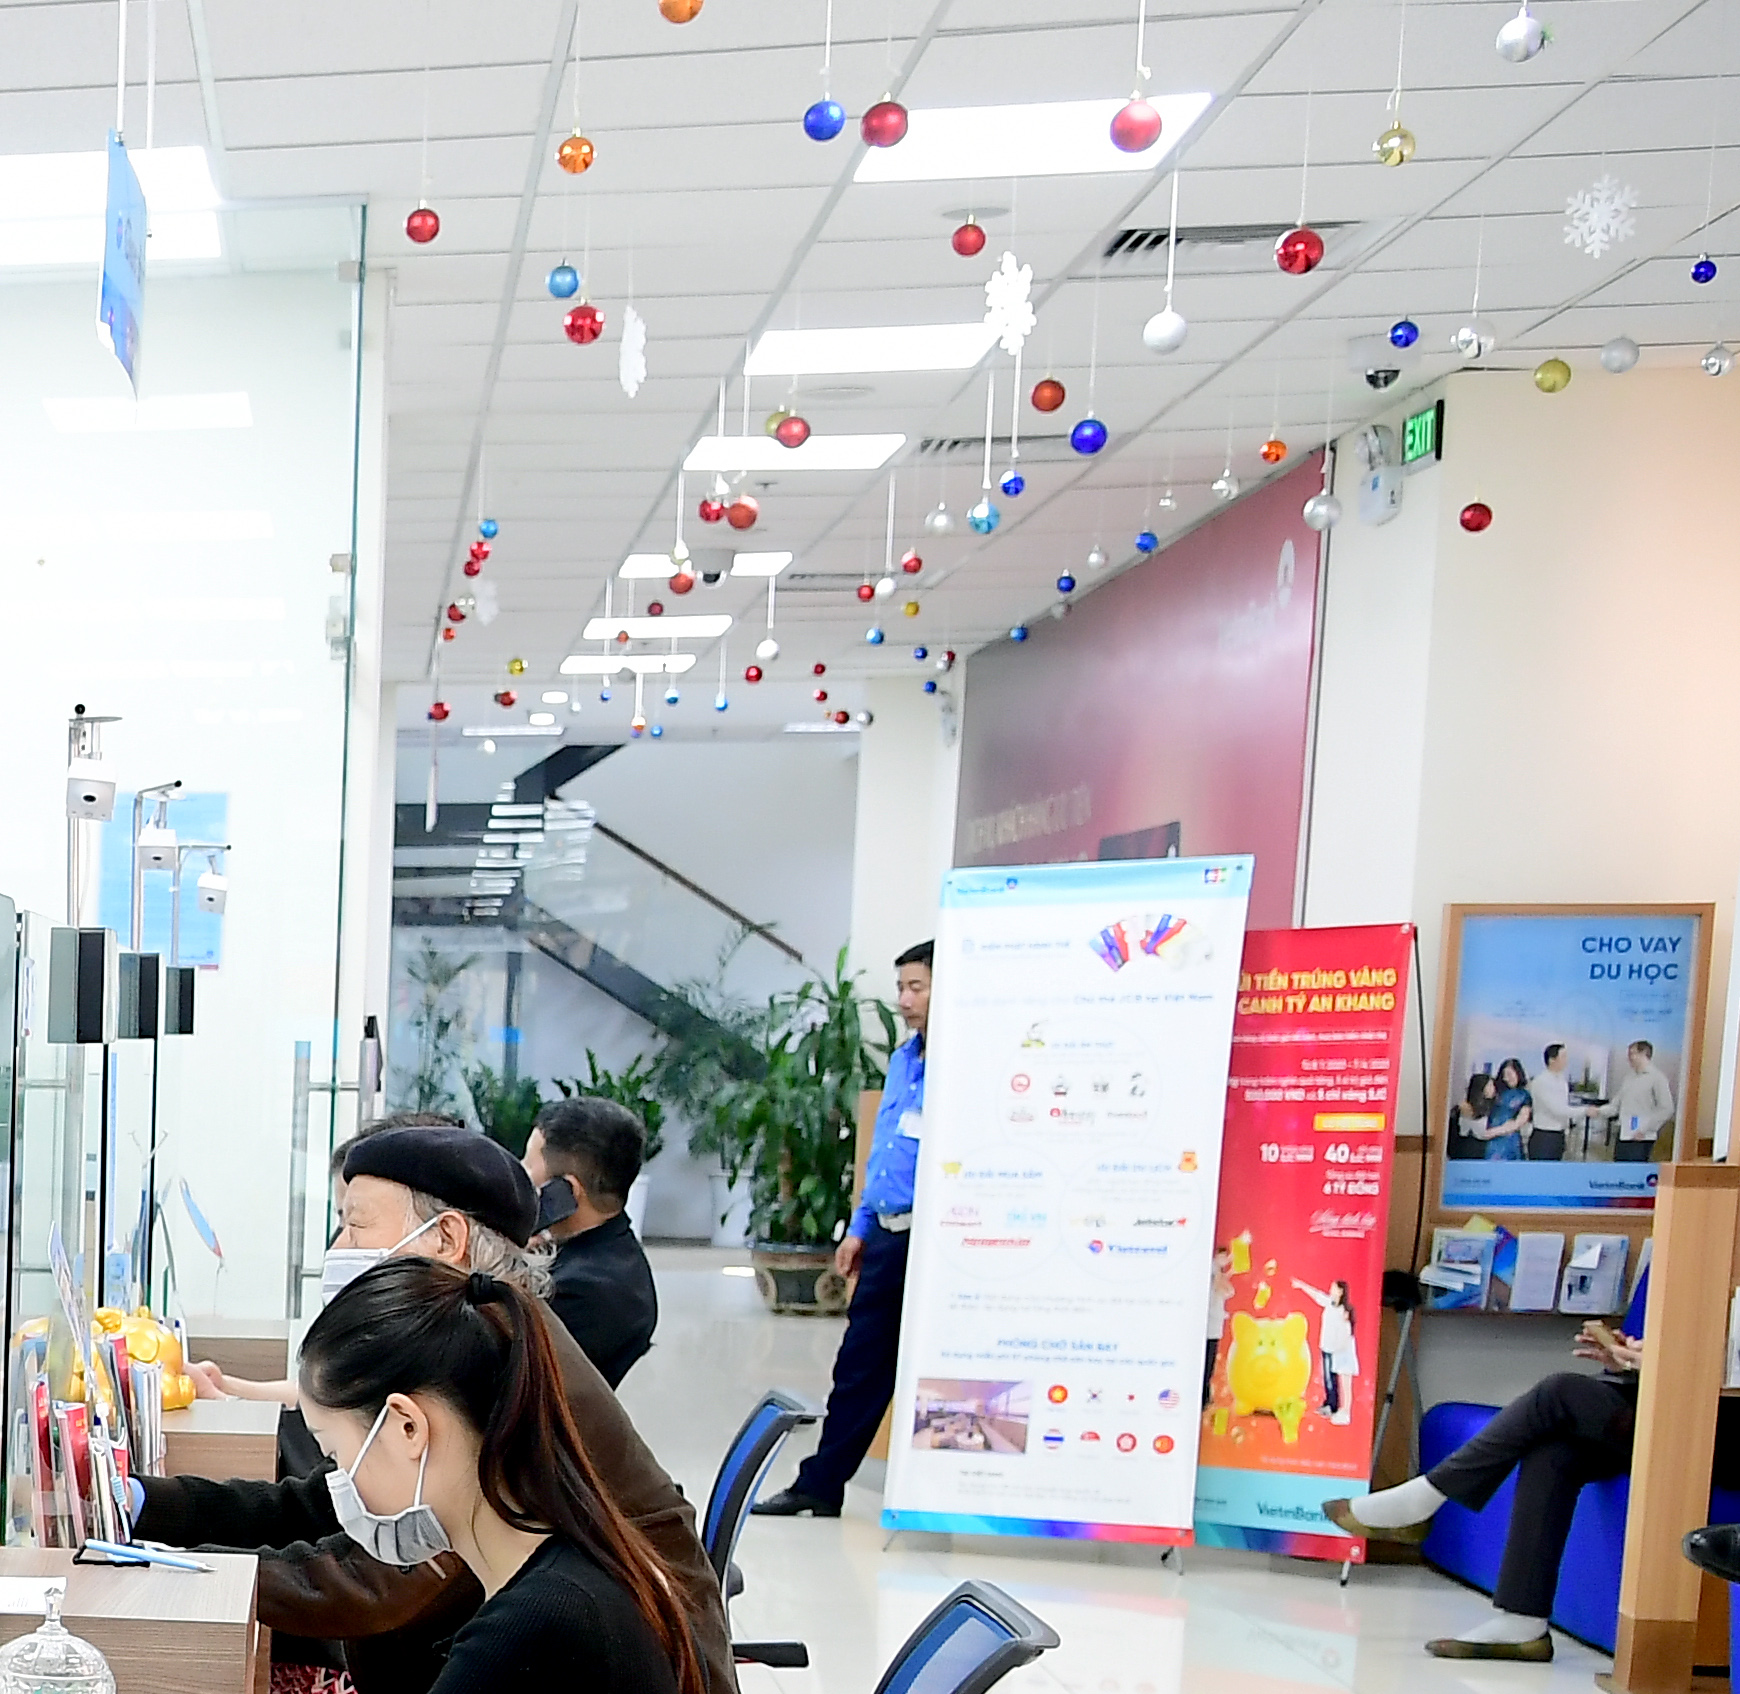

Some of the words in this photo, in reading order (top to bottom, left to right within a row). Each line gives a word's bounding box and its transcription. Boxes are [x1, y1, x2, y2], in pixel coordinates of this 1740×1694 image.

[1406, 410, 1434, 461] EXIT
[1581, 935, 1632, 954] CHO
[1639, 935, 1682, 954] VAY
[1290, 966, 1347, 990] TRÚNG
[1349, 965, 1398, 989] VÀNG
[1589, 963, 1622, 980] DU
[1628, 963, 1679, 986] HỌC
[1238, 996, 1284, 1015] CANH
[1308, 994, 1333, 1013] AN
[1335, 991, 1396, 1012] KHANG
[1260, 1143, 1280, 1163] 10
[1324, 1143, 1350, 1163] 40
